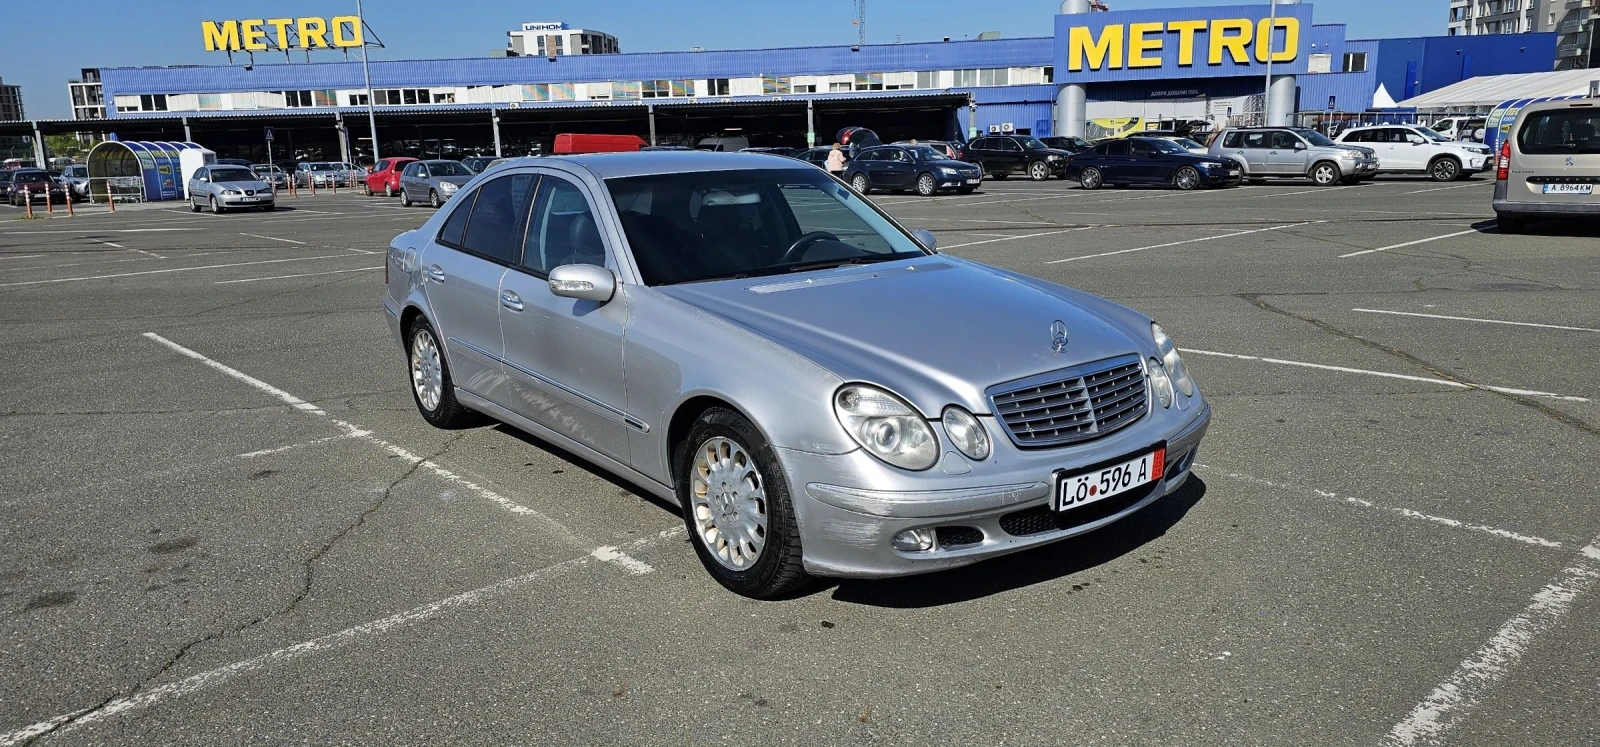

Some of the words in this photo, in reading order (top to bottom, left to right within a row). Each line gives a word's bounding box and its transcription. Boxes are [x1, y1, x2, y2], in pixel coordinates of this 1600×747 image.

[202, 16, 362, 51] METRO
[1068, 17, 1300, 71] METRO
[1062, 476, 1089, 507] LÖ
[1099, 463, 1132, 495] 596
[1137, 457, 1147, 483] A
